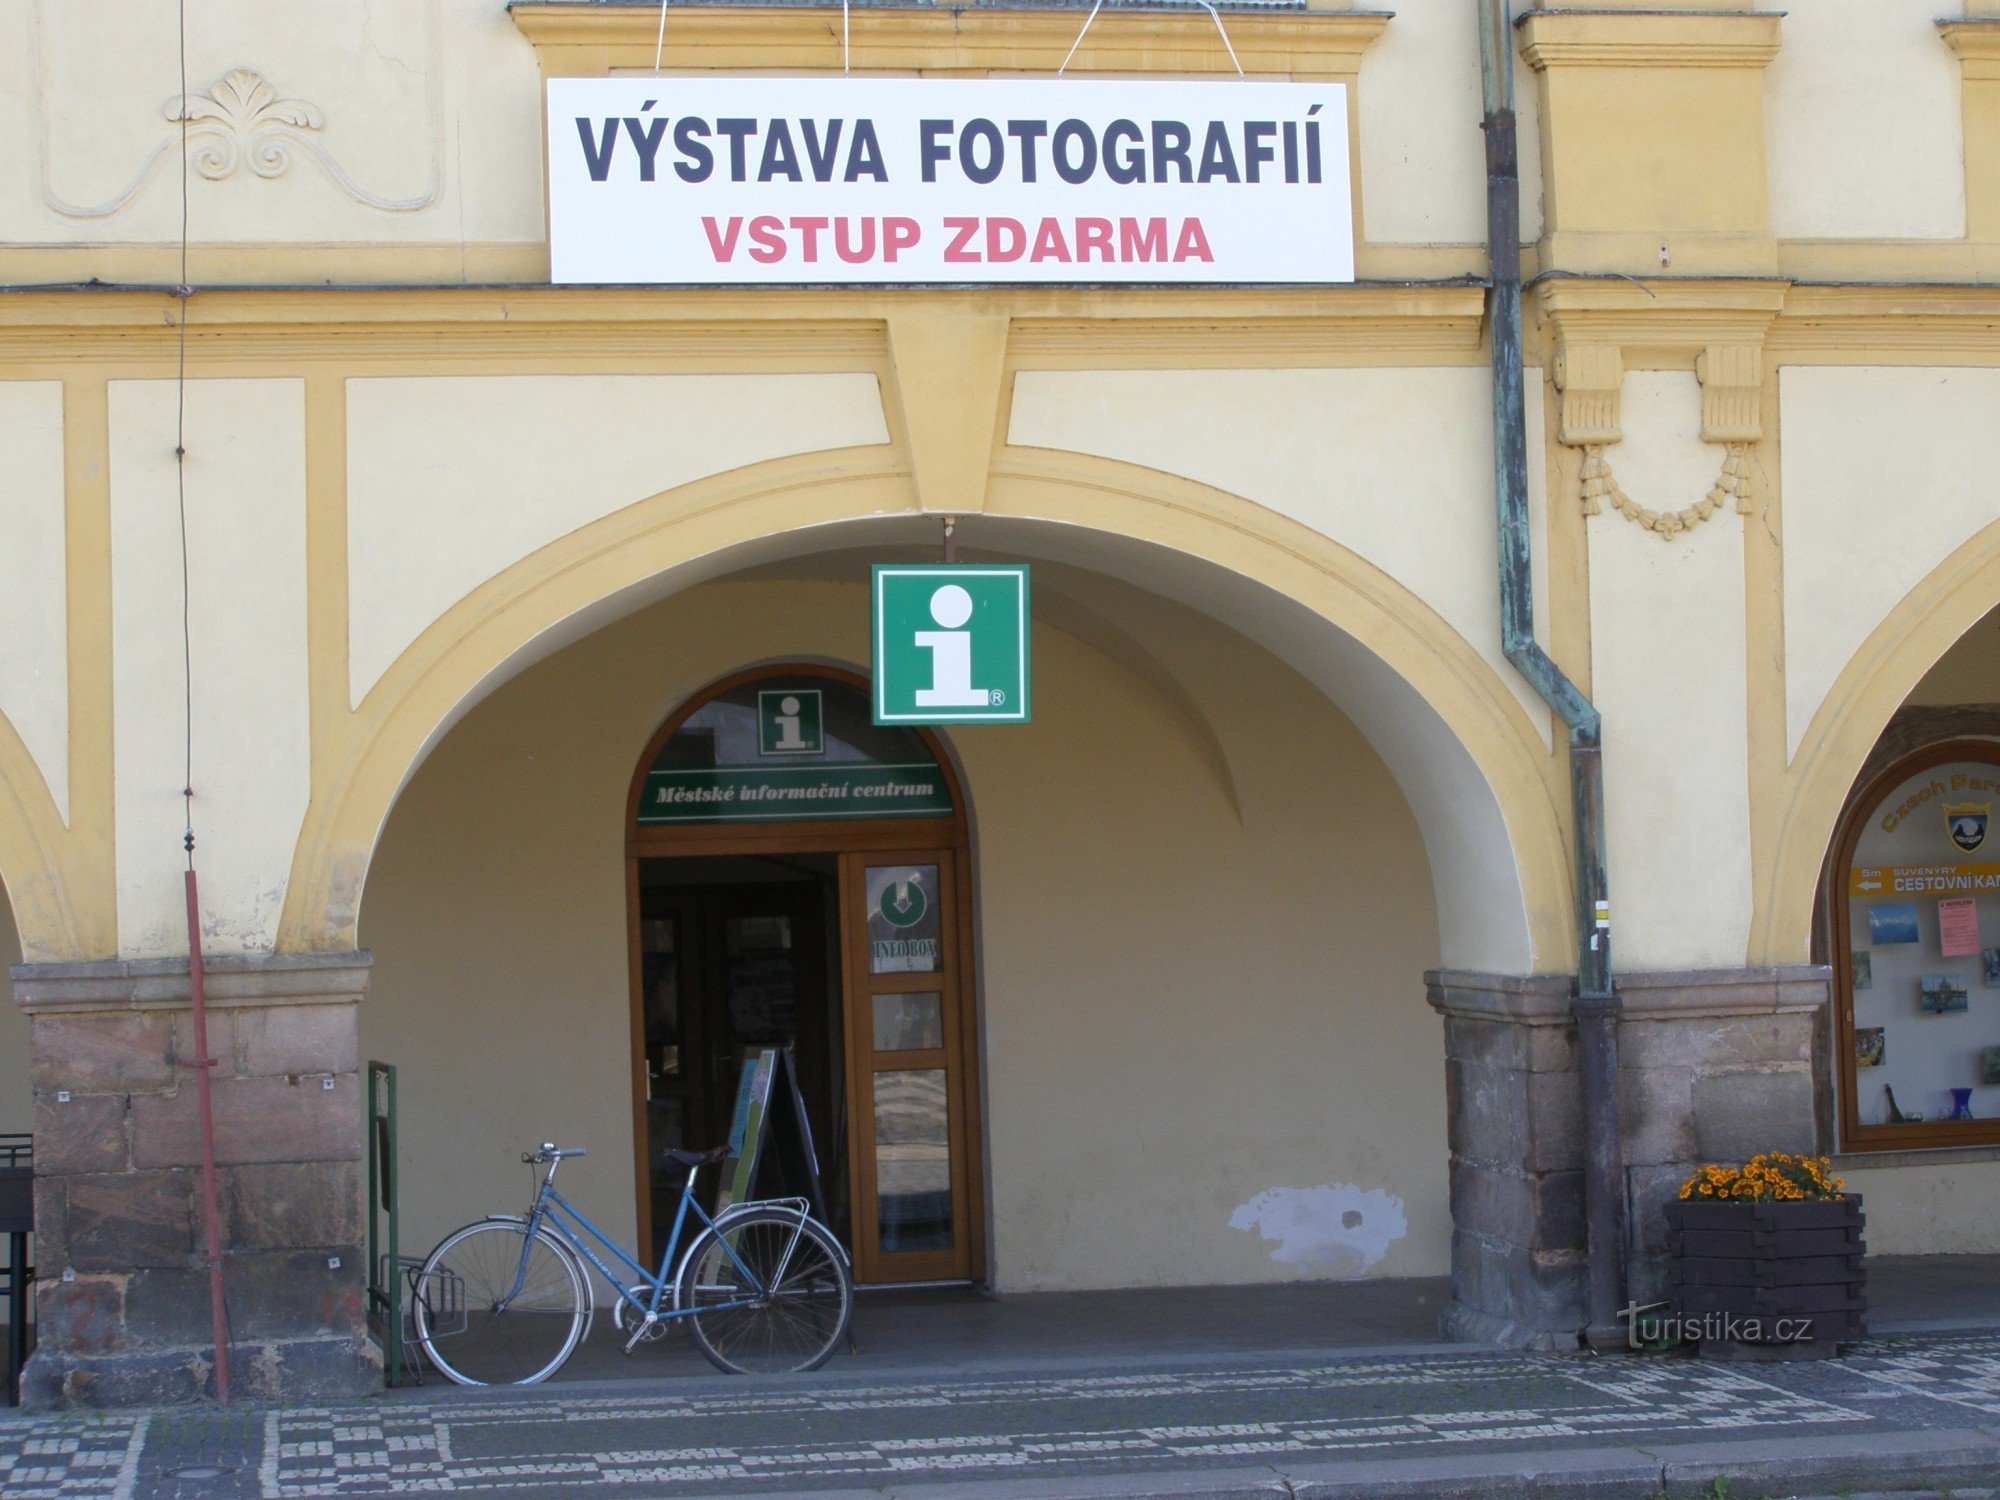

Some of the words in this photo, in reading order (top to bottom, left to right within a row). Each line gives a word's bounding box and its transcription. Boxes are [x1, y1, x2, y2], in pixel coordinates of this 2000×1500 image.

[575, 99, 889, 184] VÝSTAVA
[919, 104, 1324, 185] FOTOGRAFIÍ
[702, 215, 921, 264] VSTUP
[943, 217, 1214, 263] ZDARMA
[656, 783, 734, 803] Městské
[740, 782, 849, 801] informační
[853, 781, 935, 797] centrum
[1880, 780, 1945, 833] Czech
[1861, 868, 1882, 877] 5m
[1893, 866, 1957, 876] SUVENÝRY
[1893, 871, 1972, 892] CESTOVNÍ
[874, 940, 907, 958] INFO
[908, 939, 937, 957] BOX
